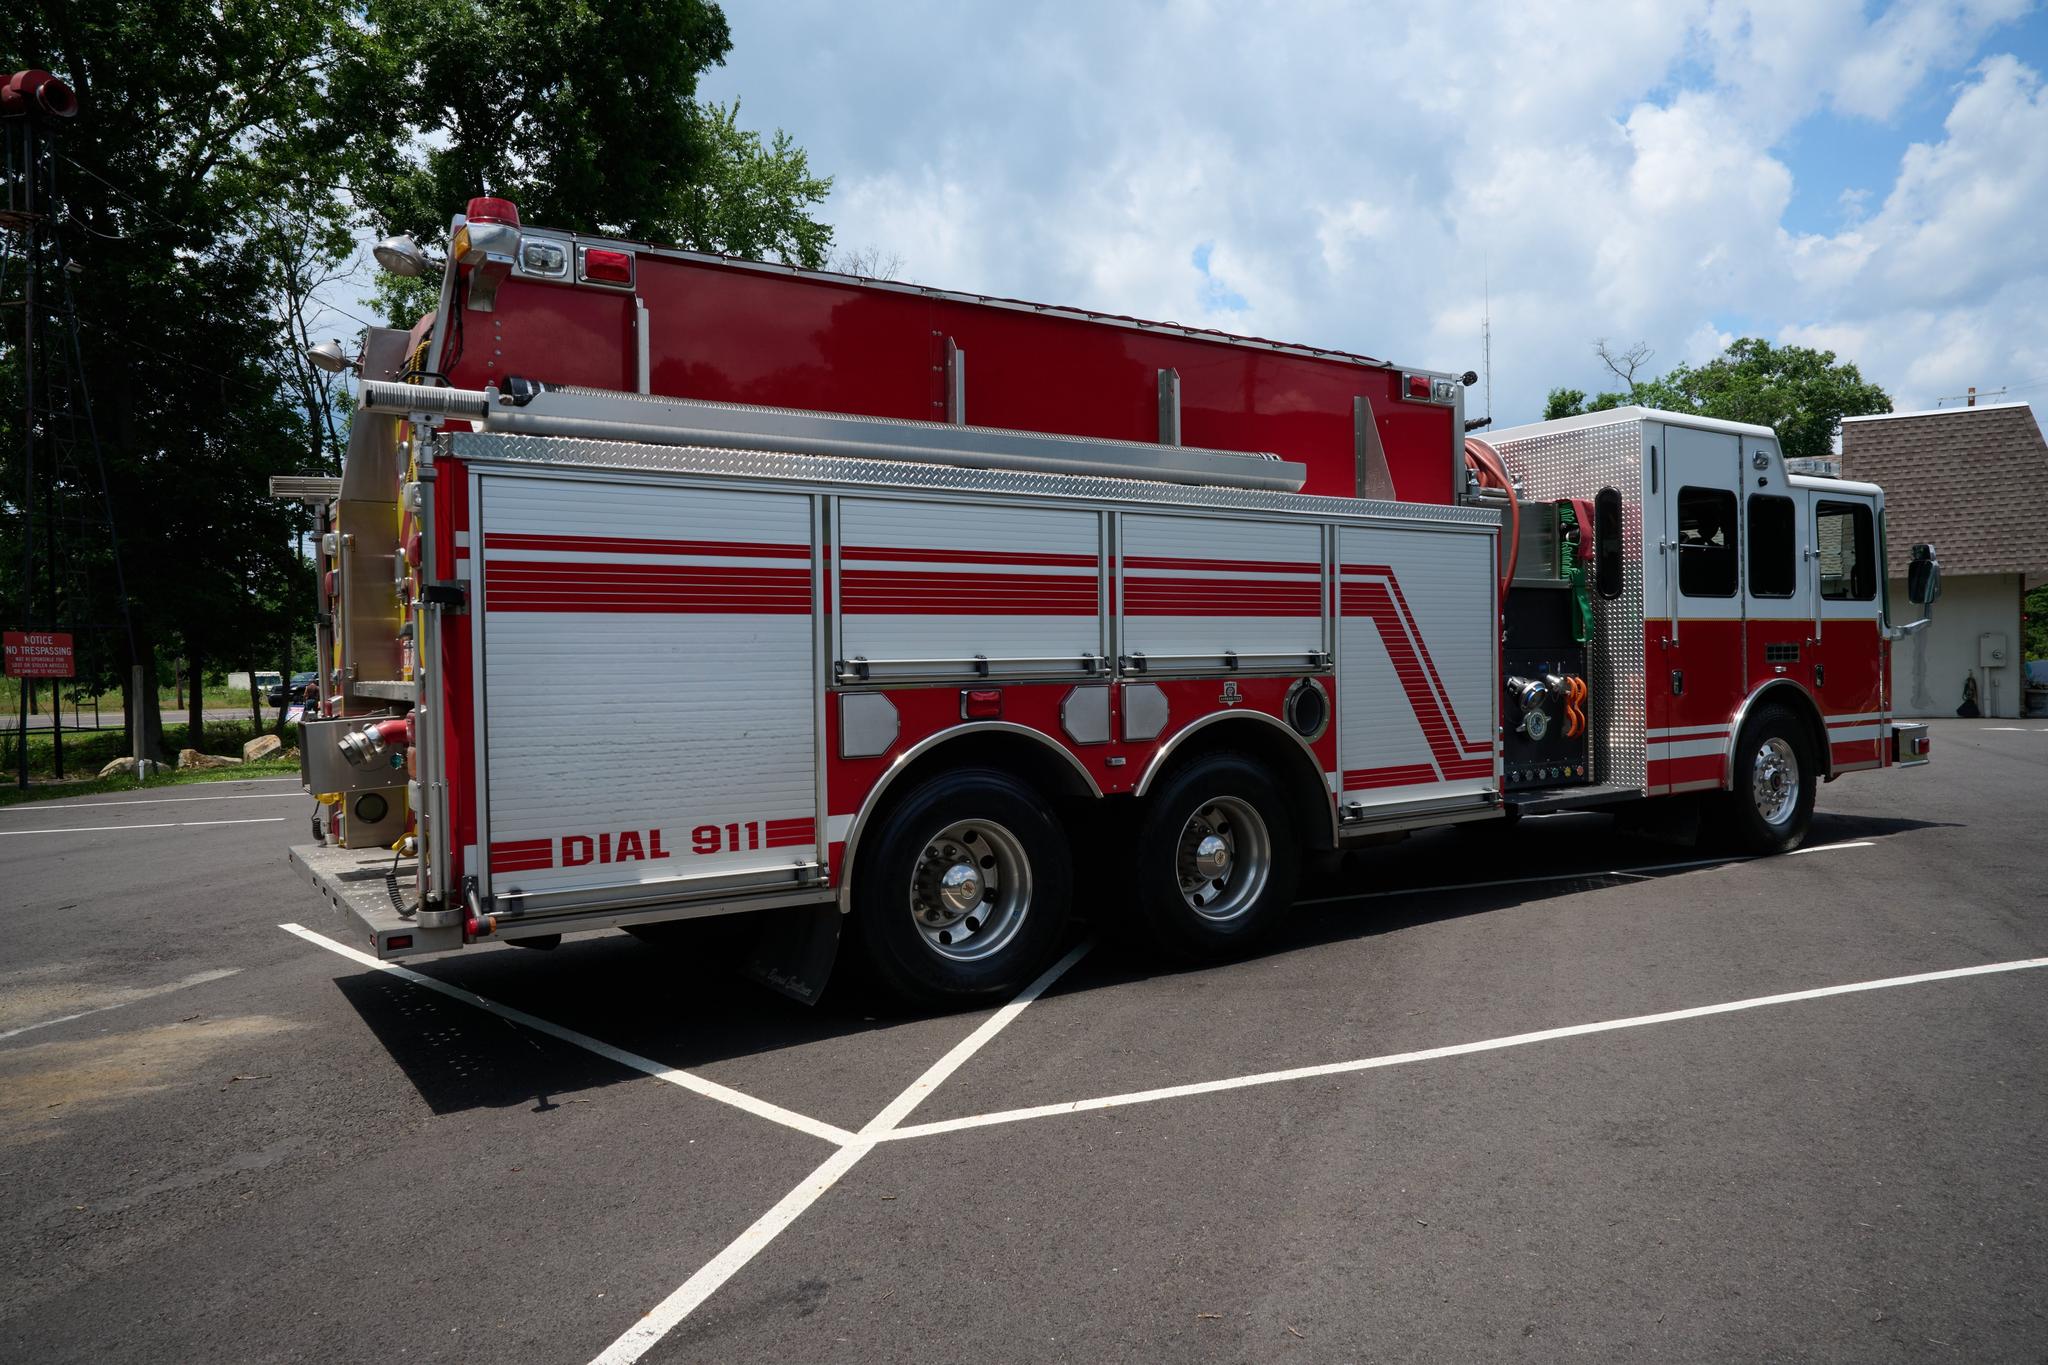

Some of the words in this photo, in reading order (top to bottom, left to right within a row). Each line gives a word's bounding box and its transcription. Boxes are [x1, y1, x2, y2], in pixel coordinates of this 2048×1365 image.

[24, 636, 53, 644] NOTICE
[6, 646, 17, 655] NO
[20, 646, 72, 656] TRESPASSING
[561, 829, 670, 867] DIAL
[692, 821, 759, 855] 911
